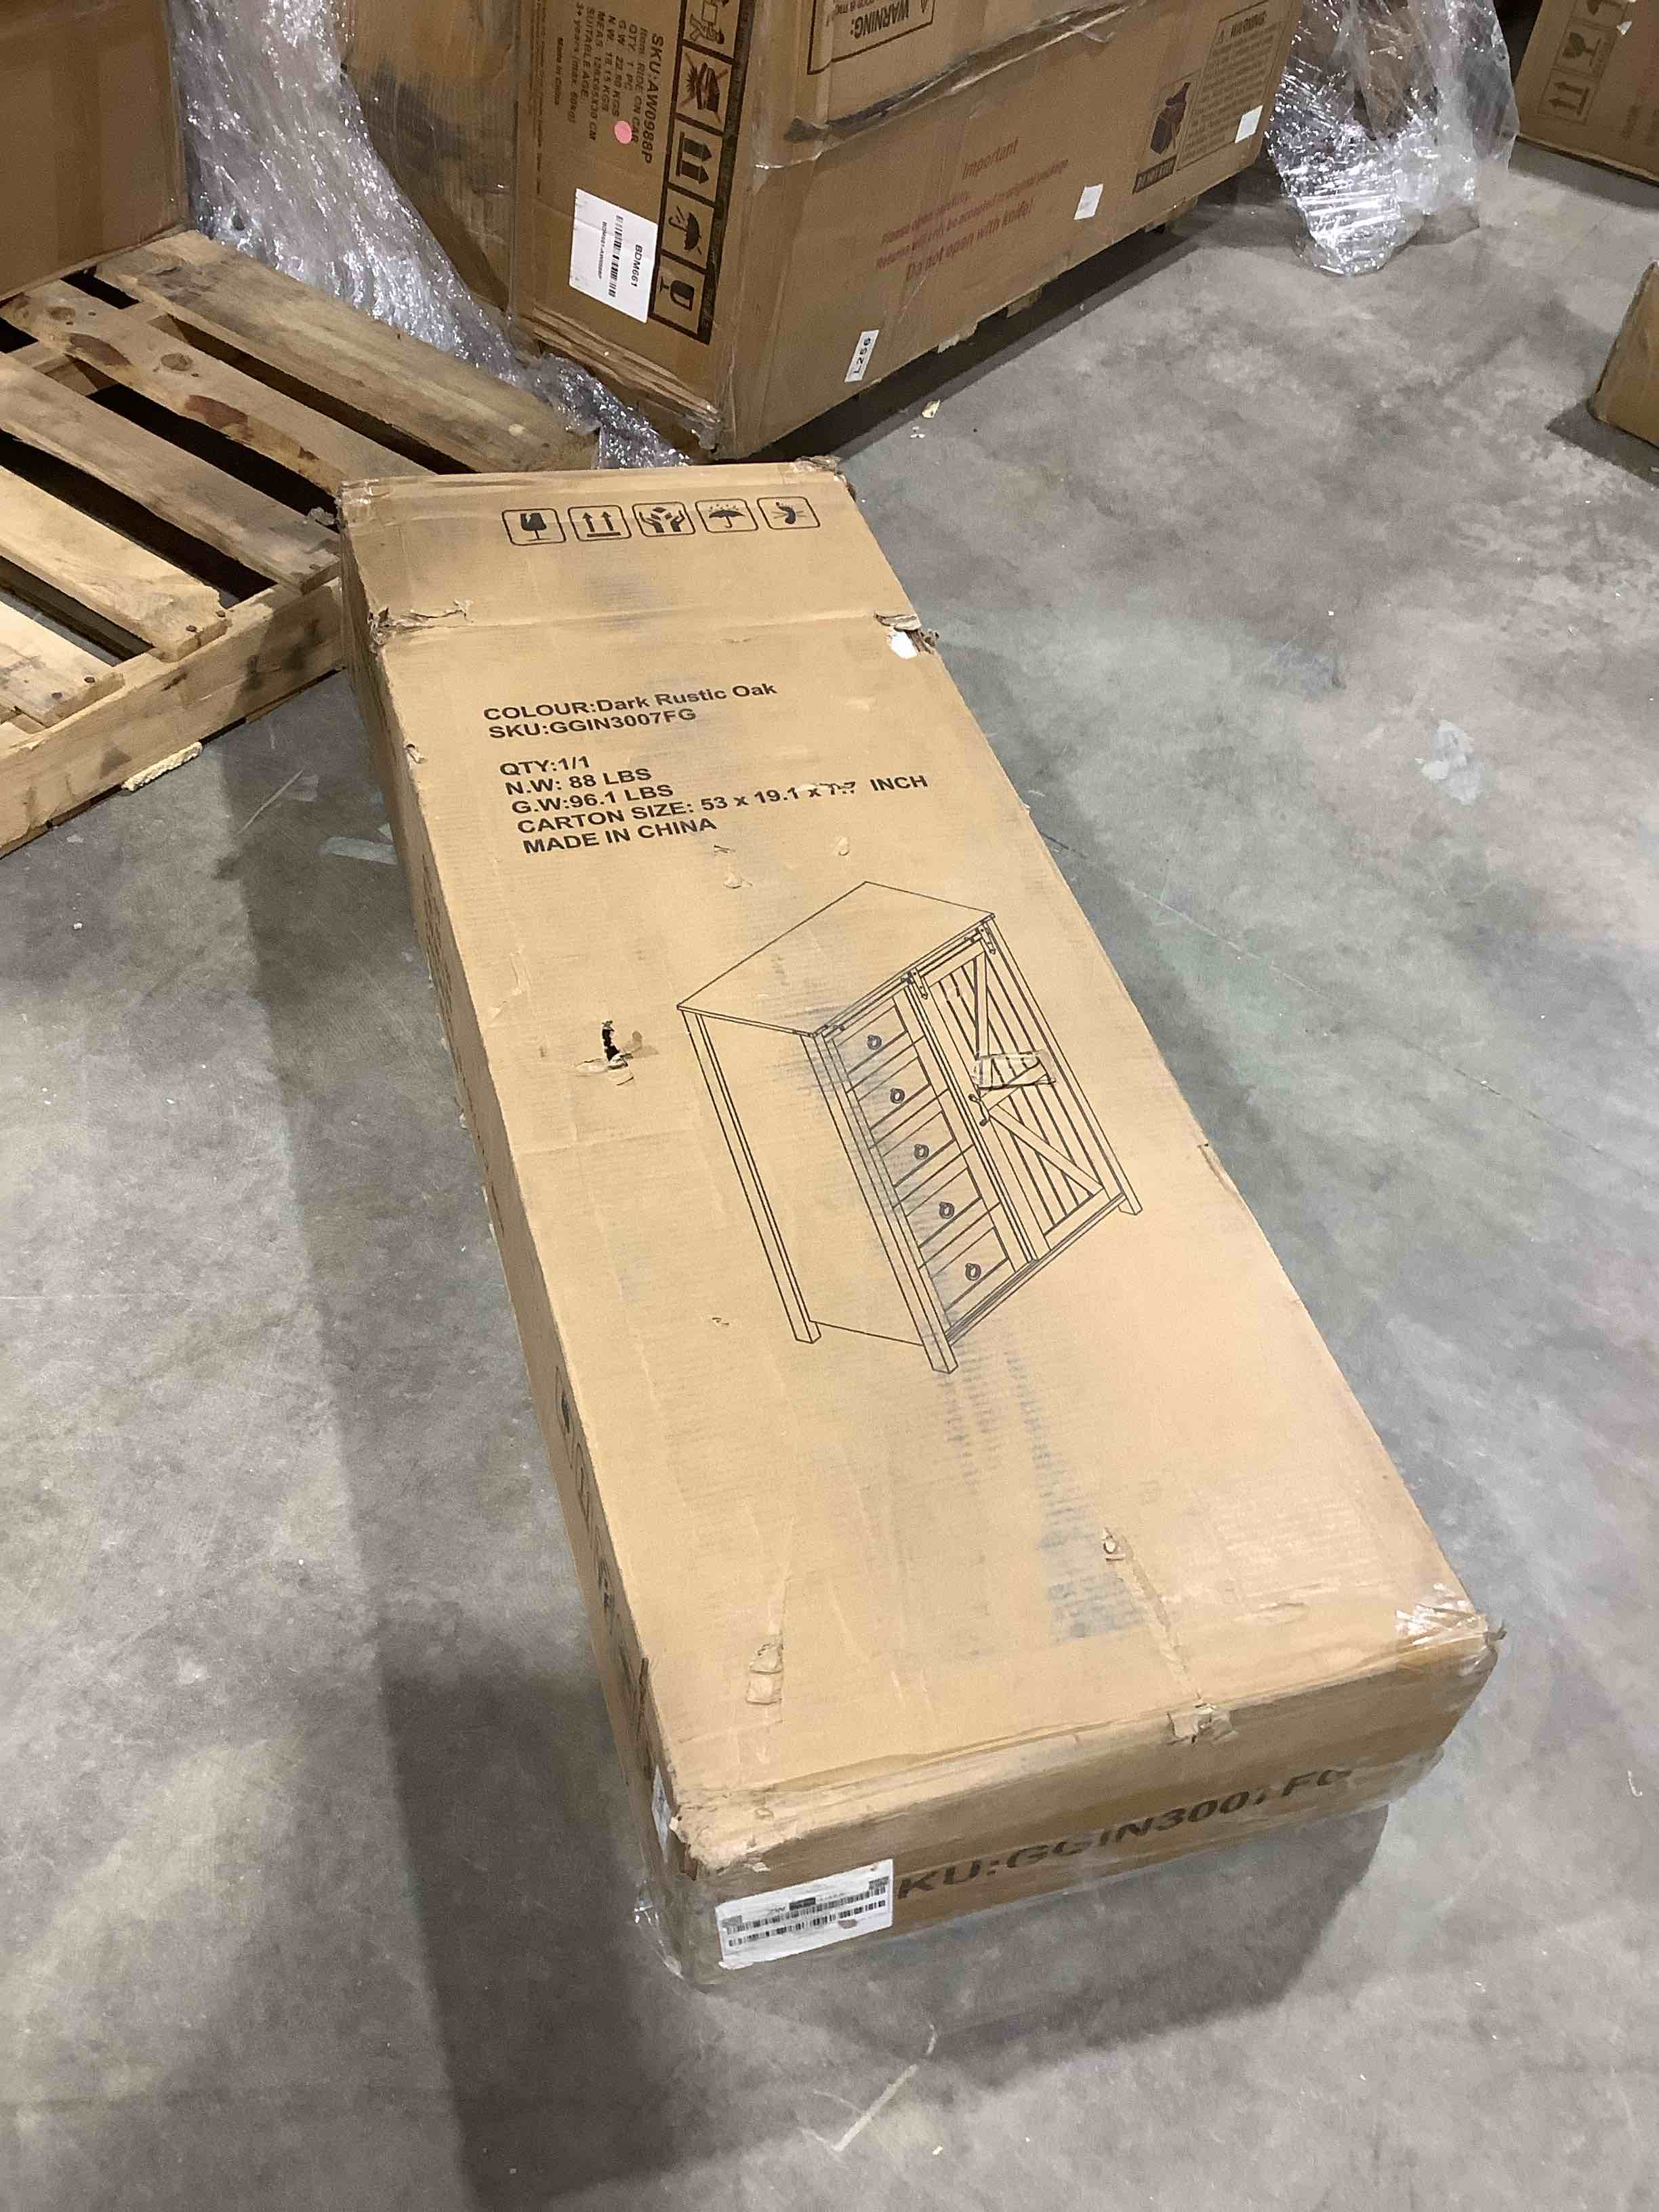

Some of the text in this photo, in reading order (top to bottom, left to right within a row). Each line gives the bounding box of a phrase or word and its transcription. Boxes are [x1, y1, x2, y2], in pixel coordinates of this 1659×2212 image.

[635, 62, 645, 92] RIDE
[640, 33, 664, 163] SKU:AW0988P
[631, 244, 643, 288] BDM661
[483, 683, 778, 720] COLOUR:Dark Rustic Oak
[489, 708, 696, 739] SKU:GGIN3007FG
[499, 756, 590, 776] QTY:1/1
[505, 769, 652, 795] N.W: 88 LBS
[512, 785, 674, 813] G.W:96.1 LBS
[518, 810, 625, 834] CARTON
[631, 802, 694, 819] SIZE:
[700, 796, 728, 811] 53
[733, 796, 749, 807] x
[754, 787, 799, 804] 19.1
[869, 775, 928, 792] INCH
[523, 819, 717, 854] MADE IN CHINA
